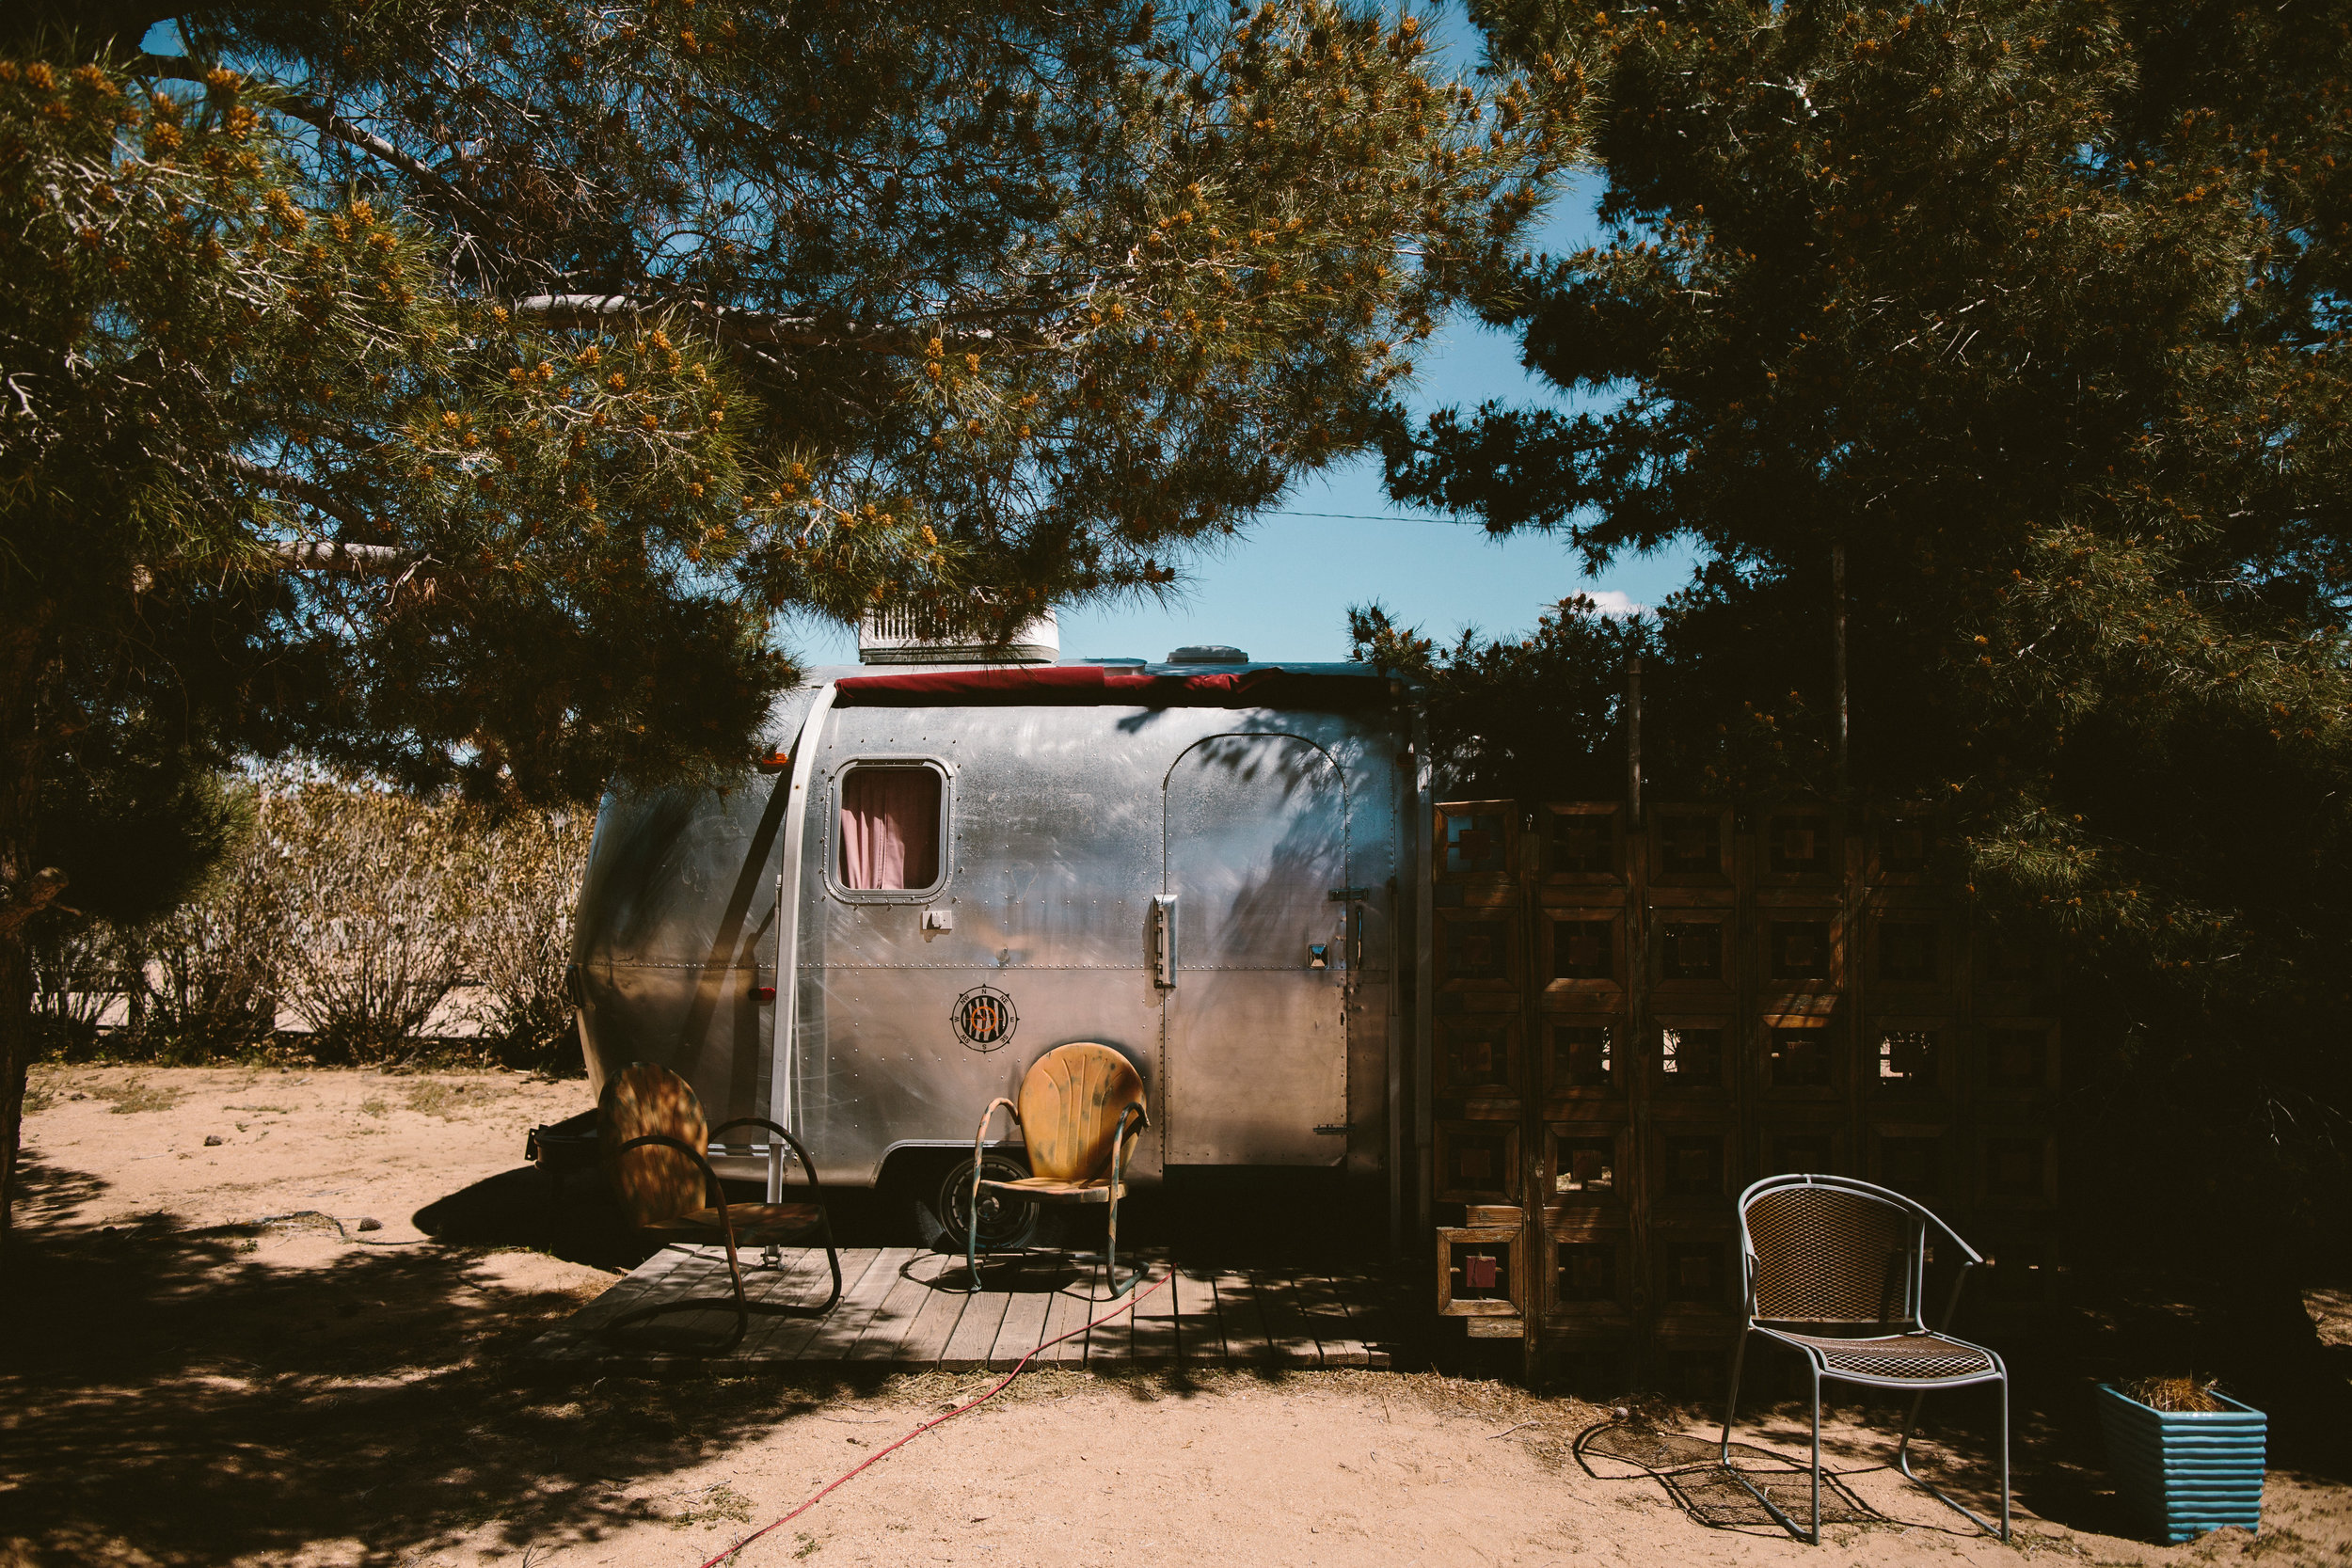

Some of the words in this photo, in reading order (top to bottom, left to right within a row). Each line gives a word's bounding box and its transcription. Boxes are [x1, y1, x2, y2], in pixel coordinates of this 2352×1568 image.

[960, 994, 970, 1005] NW
[999, 994, 1009, 1005] NE
[960, 1034, 971, 1044] SW
[999, 1034, 1009, 1043] SE
